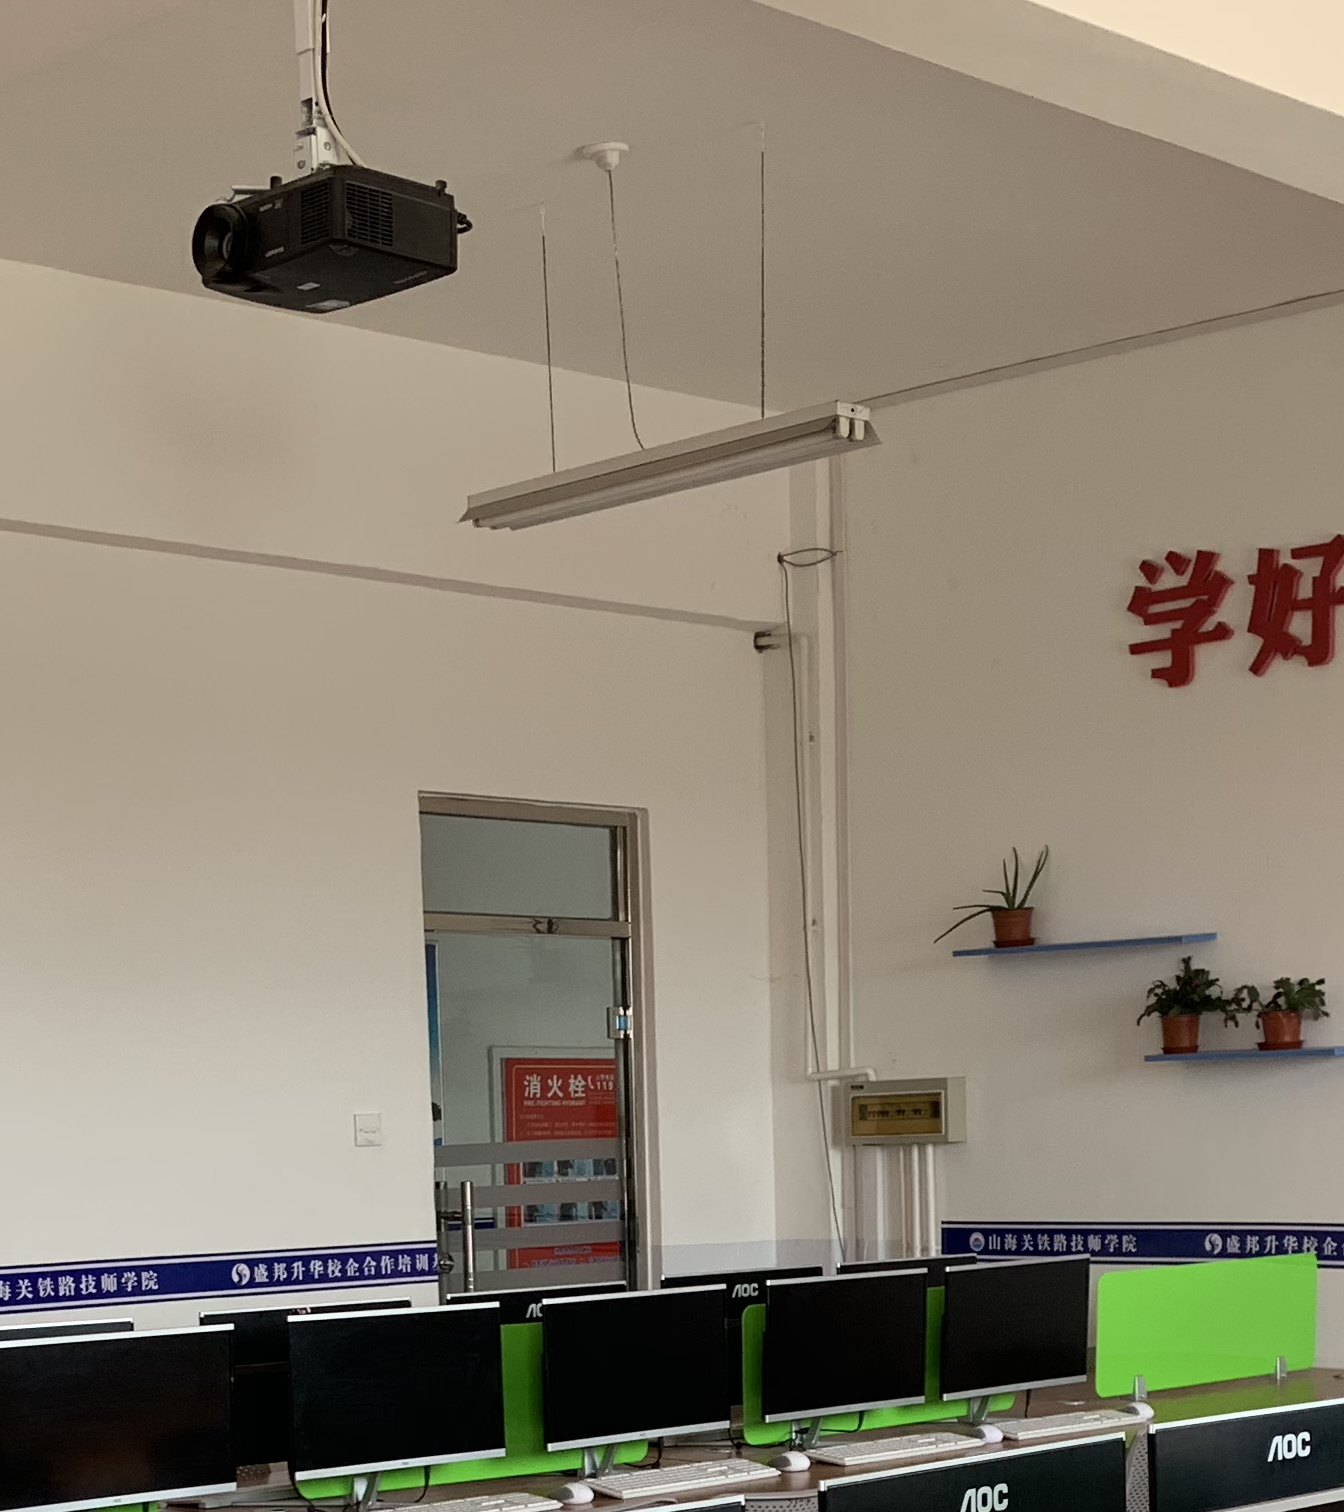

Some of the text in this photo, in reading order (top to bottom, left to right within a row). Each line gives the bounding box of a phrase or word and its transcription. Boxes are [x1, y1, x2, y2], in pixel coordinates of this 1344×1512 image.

[524, 1073, 587, 1098] 消火栓
[596, 1080, 614, 1091] 119
[988, 1232, 1138, 1254] 山海关铁路技师学院
[731, 1283, 758, 1298] AOC
[526, 1303, 542, 1319] AO
[1267, 1431, 1311, 1463] AOC
